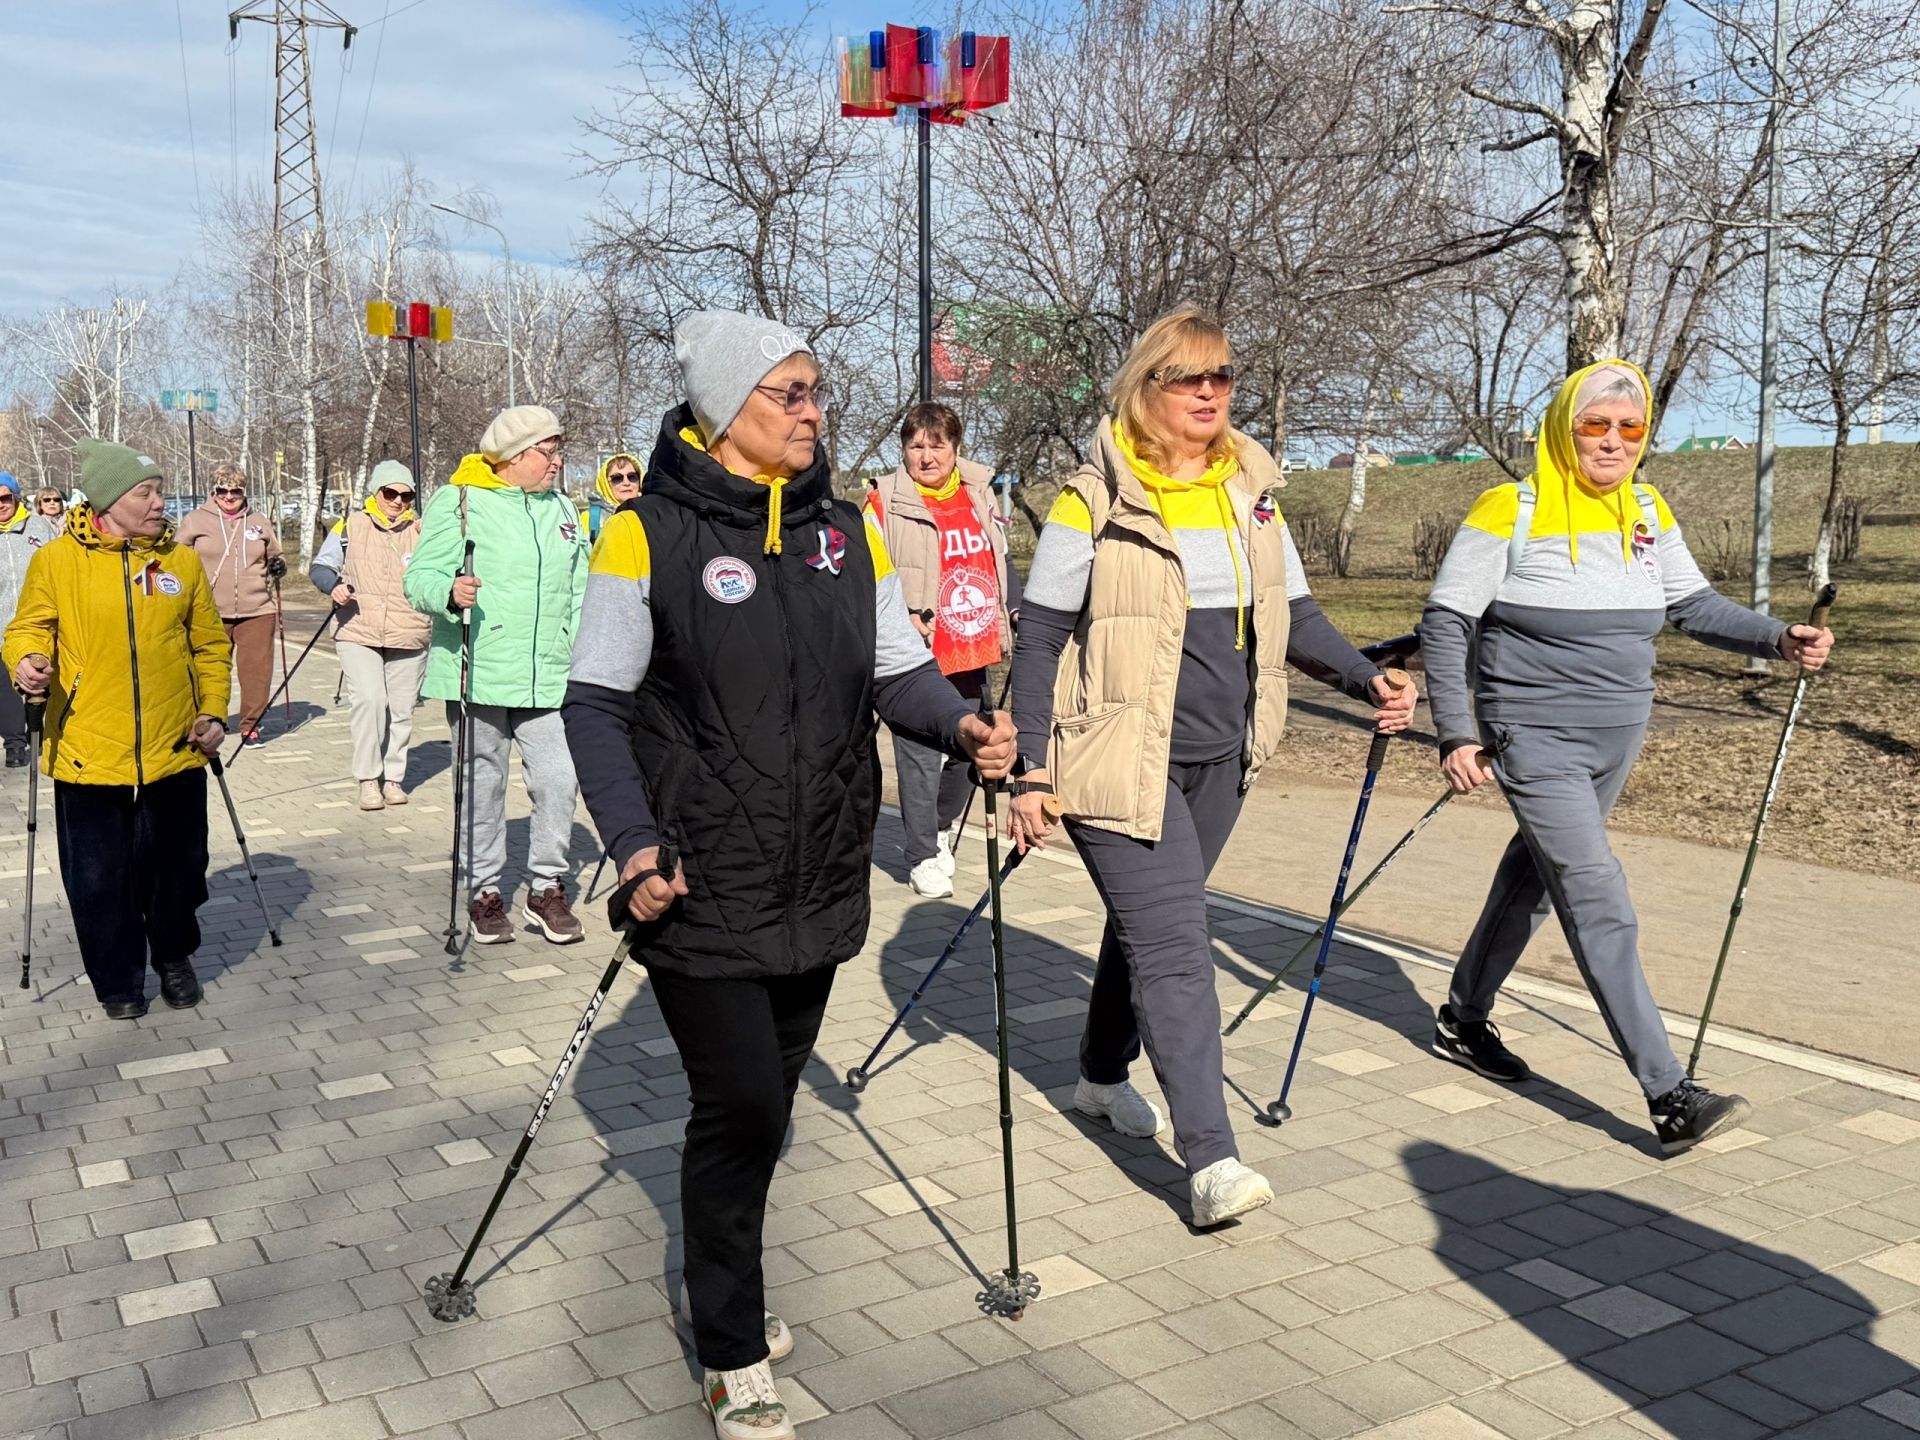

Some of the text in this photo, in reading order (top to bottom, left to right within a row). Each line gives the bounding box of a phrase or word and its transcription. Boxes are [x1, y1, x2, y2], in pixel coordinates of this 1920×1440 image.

[723, 585, 745, 593] ЕДИНАЯ
[724, 589, 746, 597] РОССИЯ
[960, 610, 980, 620] ГТО
